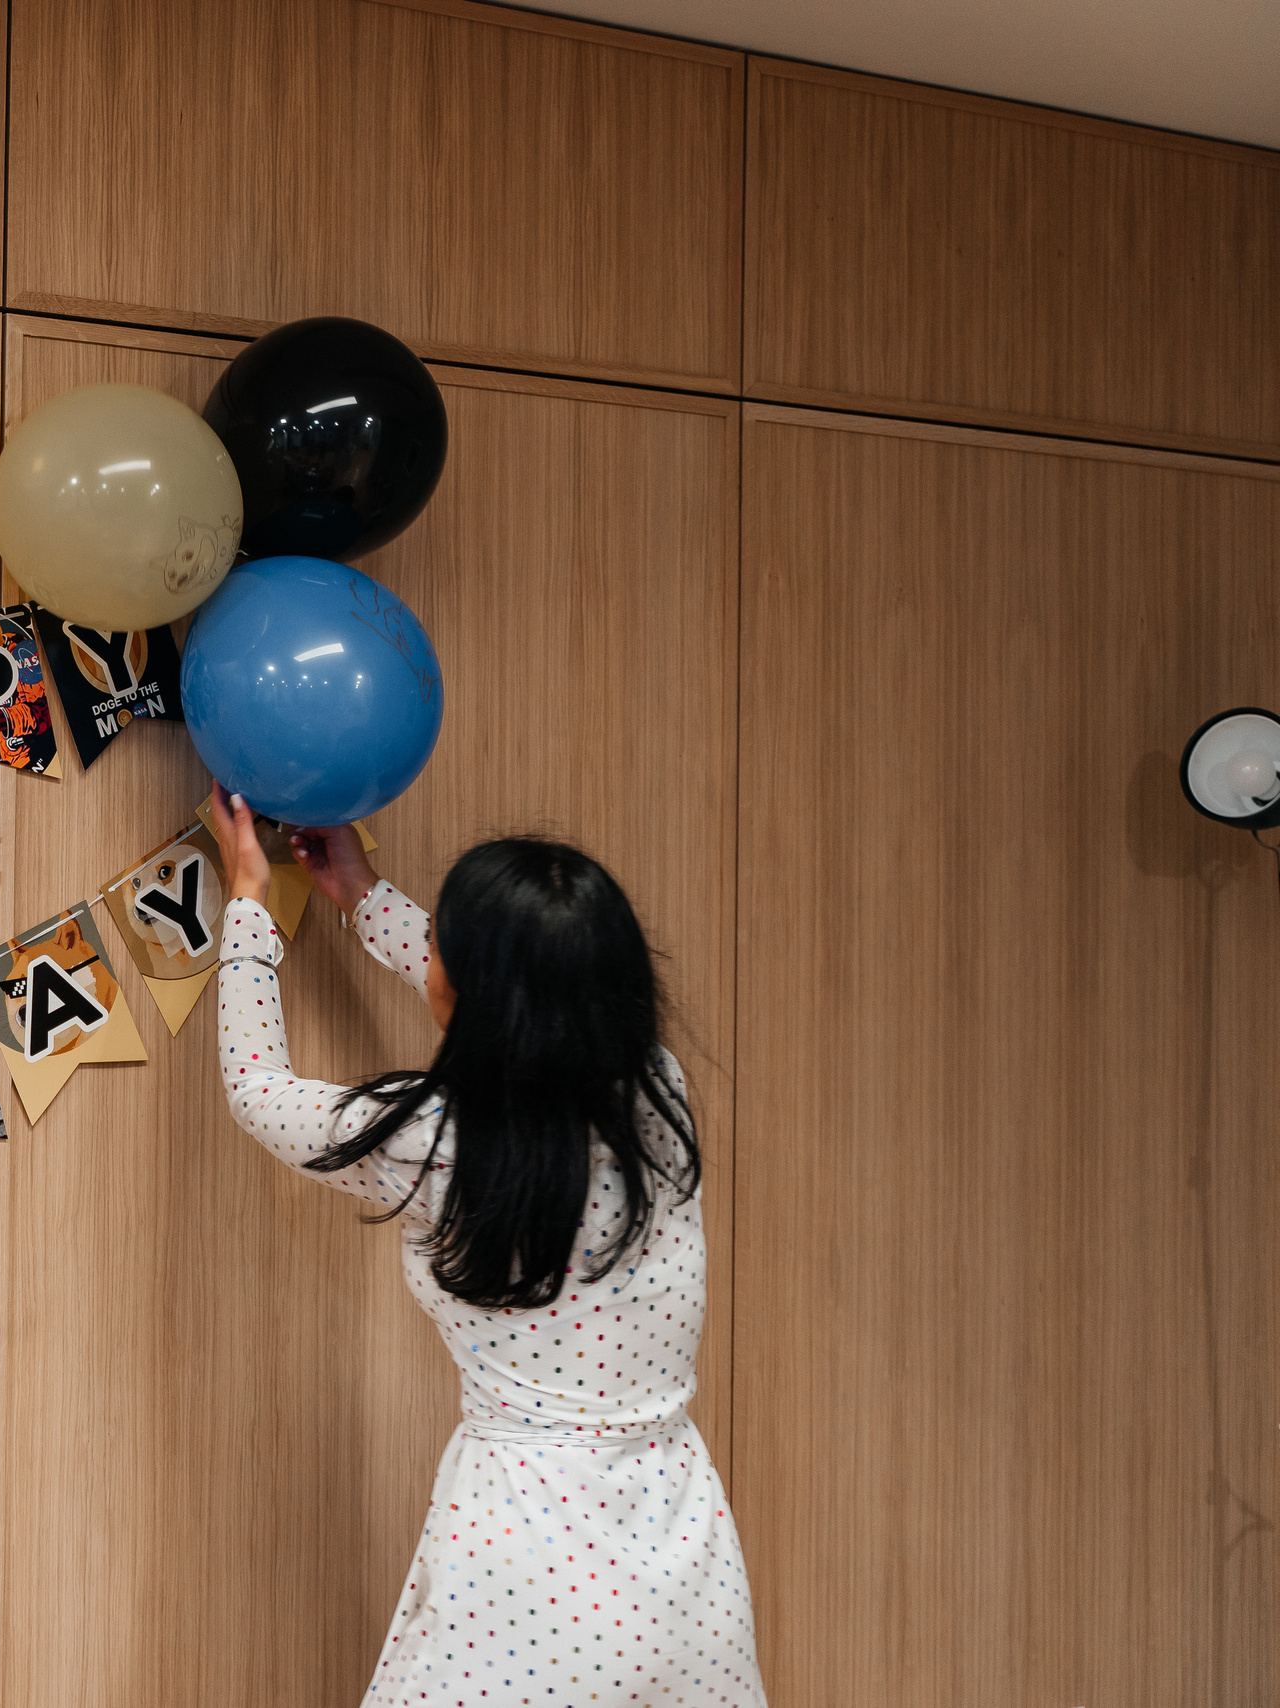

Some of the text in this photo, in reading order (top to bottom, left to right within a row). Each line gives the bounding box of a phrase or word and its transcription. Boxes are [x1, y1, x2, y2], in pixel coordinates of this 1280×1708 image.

[15, 655, 40, 669] NAS
[92, 697, 123, 716] DOGE
[138, 681, 160, 697] THE
